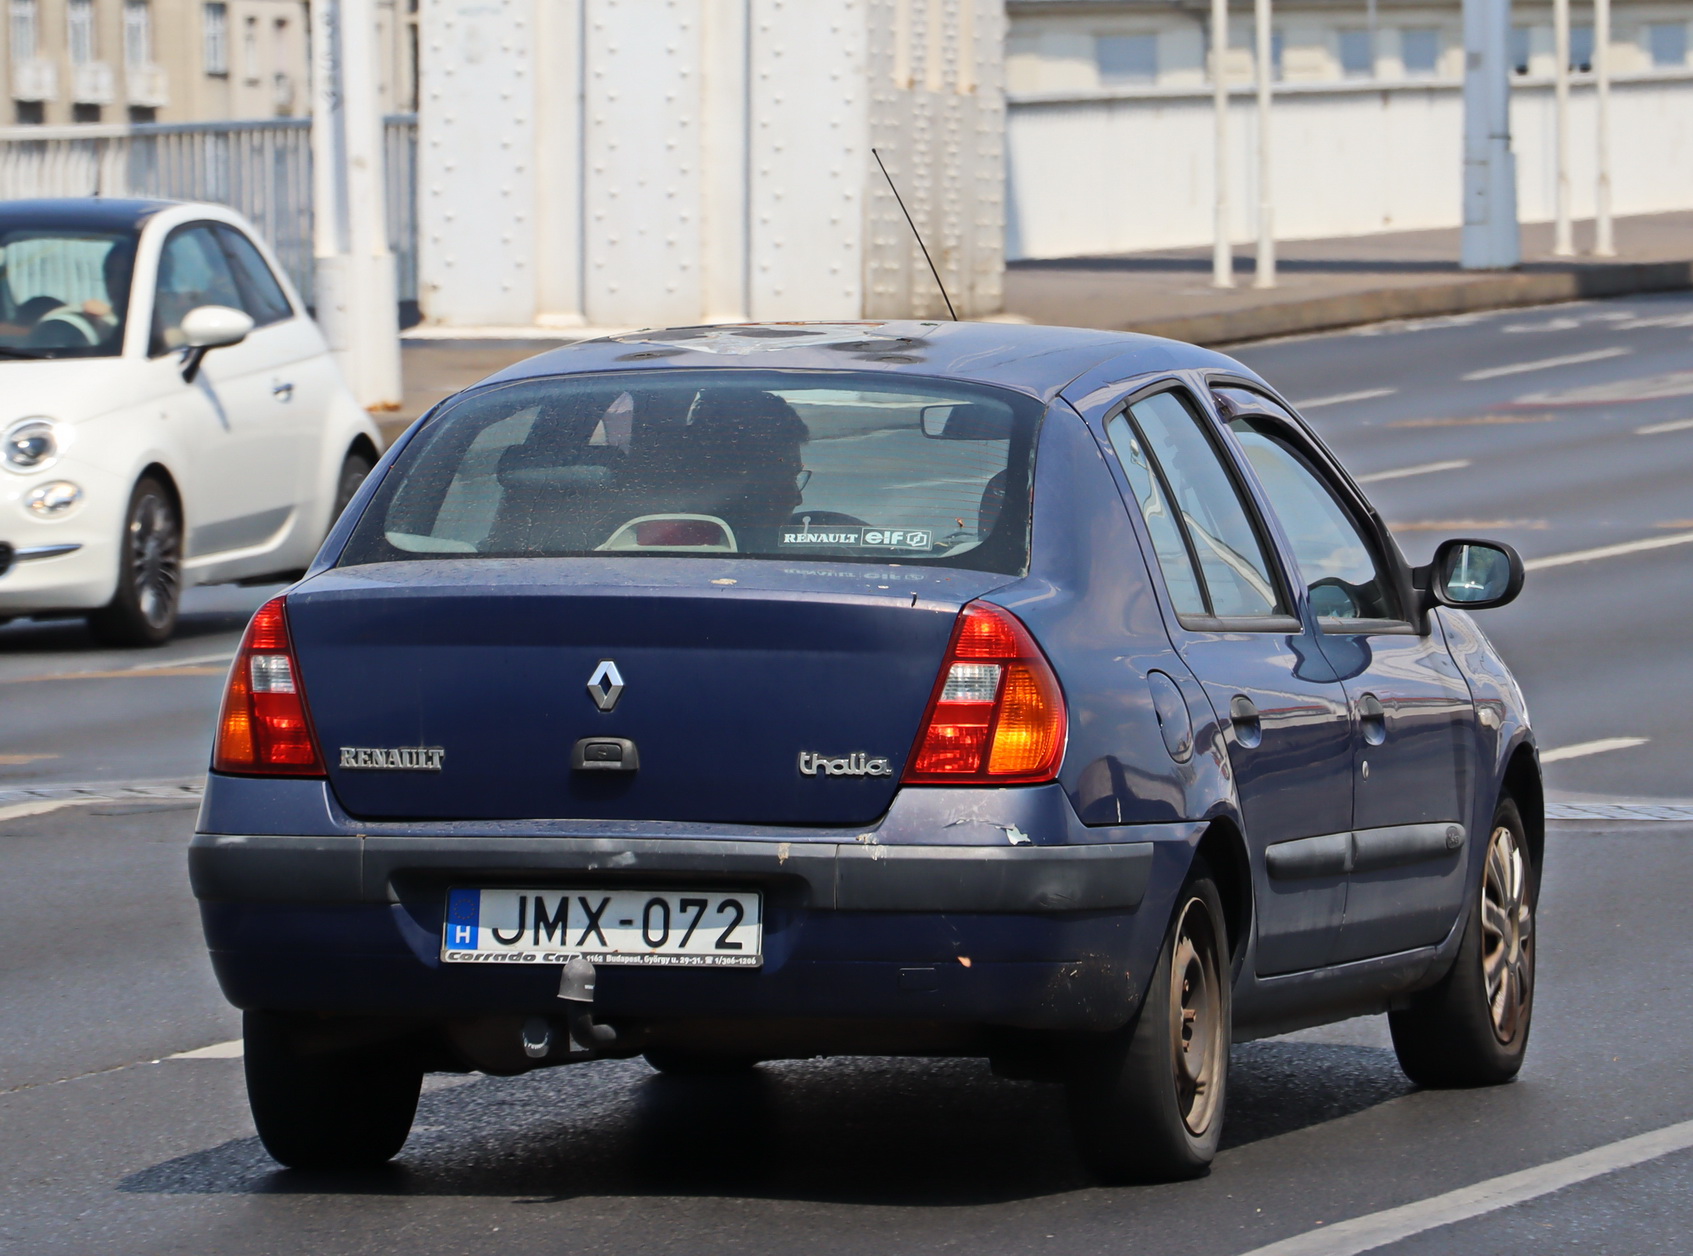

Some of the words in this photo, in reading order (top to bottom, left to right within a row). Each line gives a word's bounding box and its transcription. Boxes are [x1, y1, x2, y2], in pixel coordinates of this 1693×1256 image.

[783, 533, 858, 543] RENAULT
[865, 531, 904, 545] elf
[339, 747, 445, 769] RENAULT
[799, 751, 893, 776] thalia
[492, 896, 744, 949] JMX-072
[455, 926, 471, 943] H
[448, 952, 537, 962] Corrado
[606, 954, 643, 964] Budapest,
